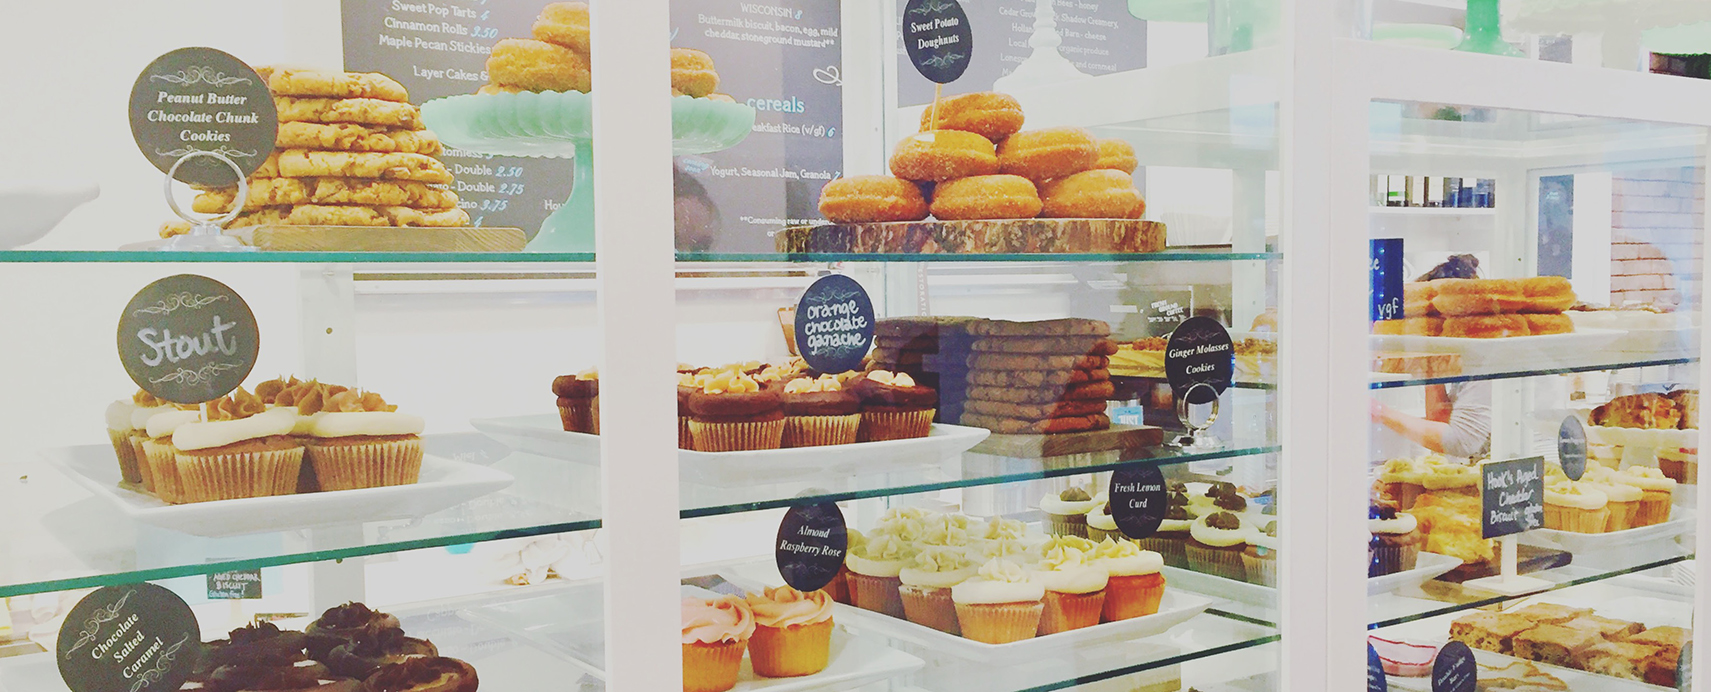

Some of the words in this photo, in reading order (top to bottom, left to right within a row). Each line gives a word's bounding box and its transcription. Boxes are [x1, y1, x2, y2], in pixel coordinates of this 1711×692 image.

[391, 0, 427, 14] Sweet
[427, 3, 449, 18] Pop
[450, 5, 477, 19] Tarts
[480, 10, 490, 21] 4
[740, 2, 792, 18] WISCONSIN
[794, 9, 803, 20] 8
[999, 6, 1019, 17] Cedar
[384, 16, 440, 33] Cinnamon
[441, 22, 468, 35] Rolls
[470, 25, 499, 39] 3.50
[698, 13, 744, 28] Buttermilk
[745, 18, 774, 31] biscuit,
[775, 21, 803, 34] bacon,
[821, 27, 838, 37] mild
[910, 20, 934, 33] Sweet
[934, 17, 959, 29] Potato
[1012, 22, 1036, 33] Hollan
[1061, 13, 1087, 24] Shadow
[1087, 16, 1119, 29] Creamery,
[379, 33, 413, 50] Maple
[414, 37, 447, 51] Pecan
[449, 40, 492, 55] Stickies
[741, 32, 792, 45] stoneground
[917, 34, 960, 50] Doughnuts
[1008, 37, 1027, 48] Local
[1084, 31, 1107, 41] cheese
[1083, 47, 1109, 56] produce
[413, 65, 444, 80] Layer
[446, 68, 479, 81] Cakes
[157, 91, 204, 104] Peanut
[206, 92, 248, 105] Butter
[746, 96, 805, 113] cereals
[147, 109, 212, 123] Chocolate
[215, 111, 259, 124] Chunk
[752, 122, 781, 133] eakfast
[180, 130, 231, 142] Cookies
[454, 163, 493, 176] Double
[495, 166, 524, 178] 2.50
[710, 165, 740, 178] Yogurt,
[741, 166, 779, 178] Seasonal
[779, 168, 800, 180] Jam,
[800, 169, 832, 180] Granola
[457, 180, 496, 193] Double
[498, 183, 525, 195] 2.75
[480, 198, 508, 212] 3.75
[807, 300, 859, 322] orange
[804, 316, 868, 336] chocolate
[136, 315, 237, 367] Stout
[807, 331, 867, 356] ganache
[1169, 347, 1195, 359] Ginger
[1195, 342, 1230, 355] Molasses
[1185, 363, 1215, 375] Cookies
[1114, 482, 1135, 493] Fresh
[1136, 482, 1161, 492] Lemon
[1128, 498, 1148, 509] Curd
[797, 525, 831, 538] Almond
[779, 540, 820, 557] Raspberry
[821, 545, 842, 557] Rose
[91, 612, 139, 660] Chocolate
[113, 630, 146, 664] Salted
[122, 636, 164, 679] Caramel
